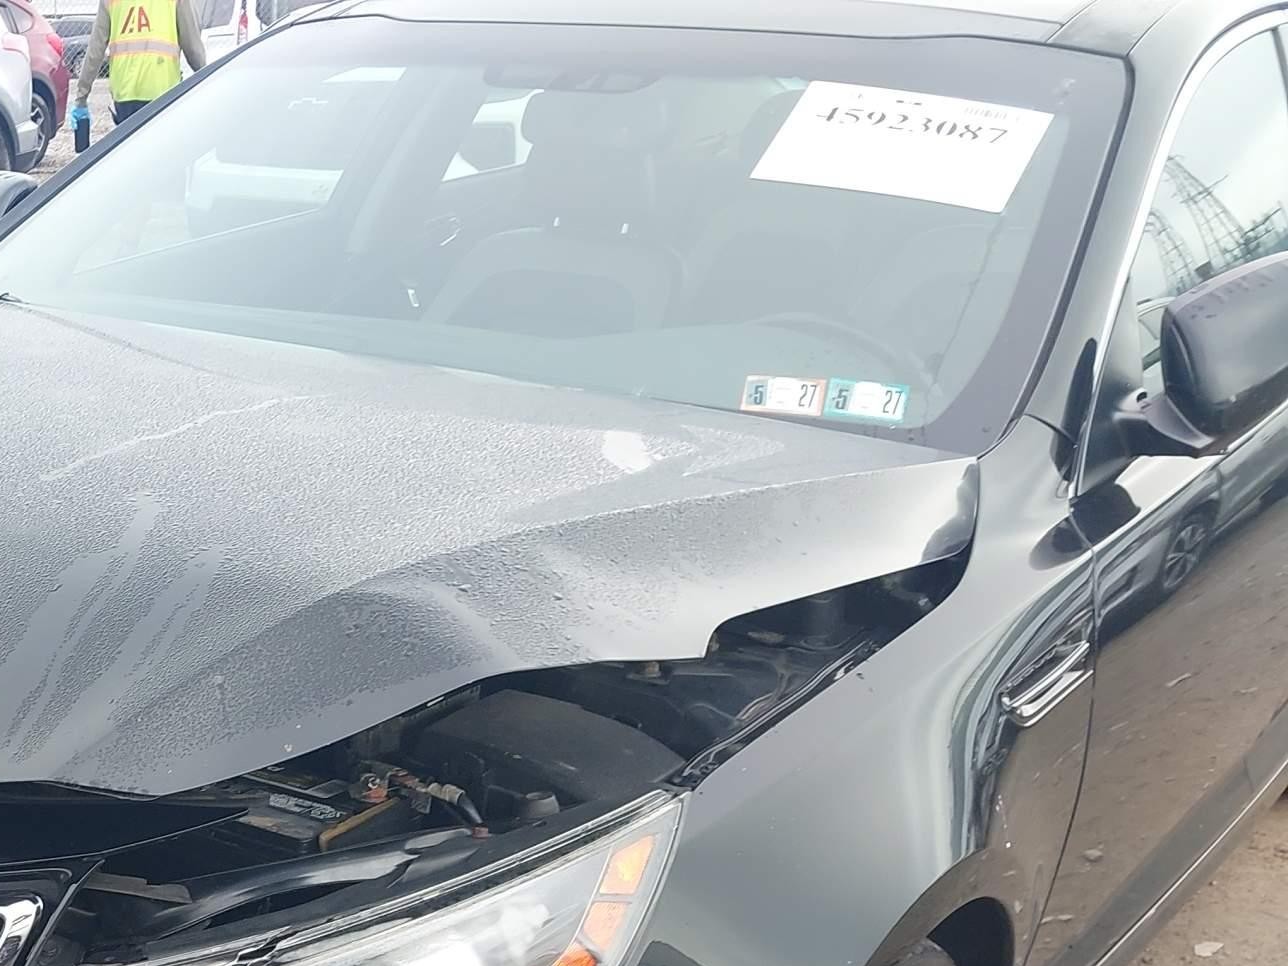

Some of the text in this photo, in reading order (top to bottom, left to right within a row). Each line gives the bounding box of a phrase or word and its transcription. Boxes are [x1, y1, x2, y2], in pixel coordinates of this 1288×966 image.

[815, 106, 1008, 145] 45923087
[798, 383, 817, 409] 27
[881, 389, 903, 416] 27
